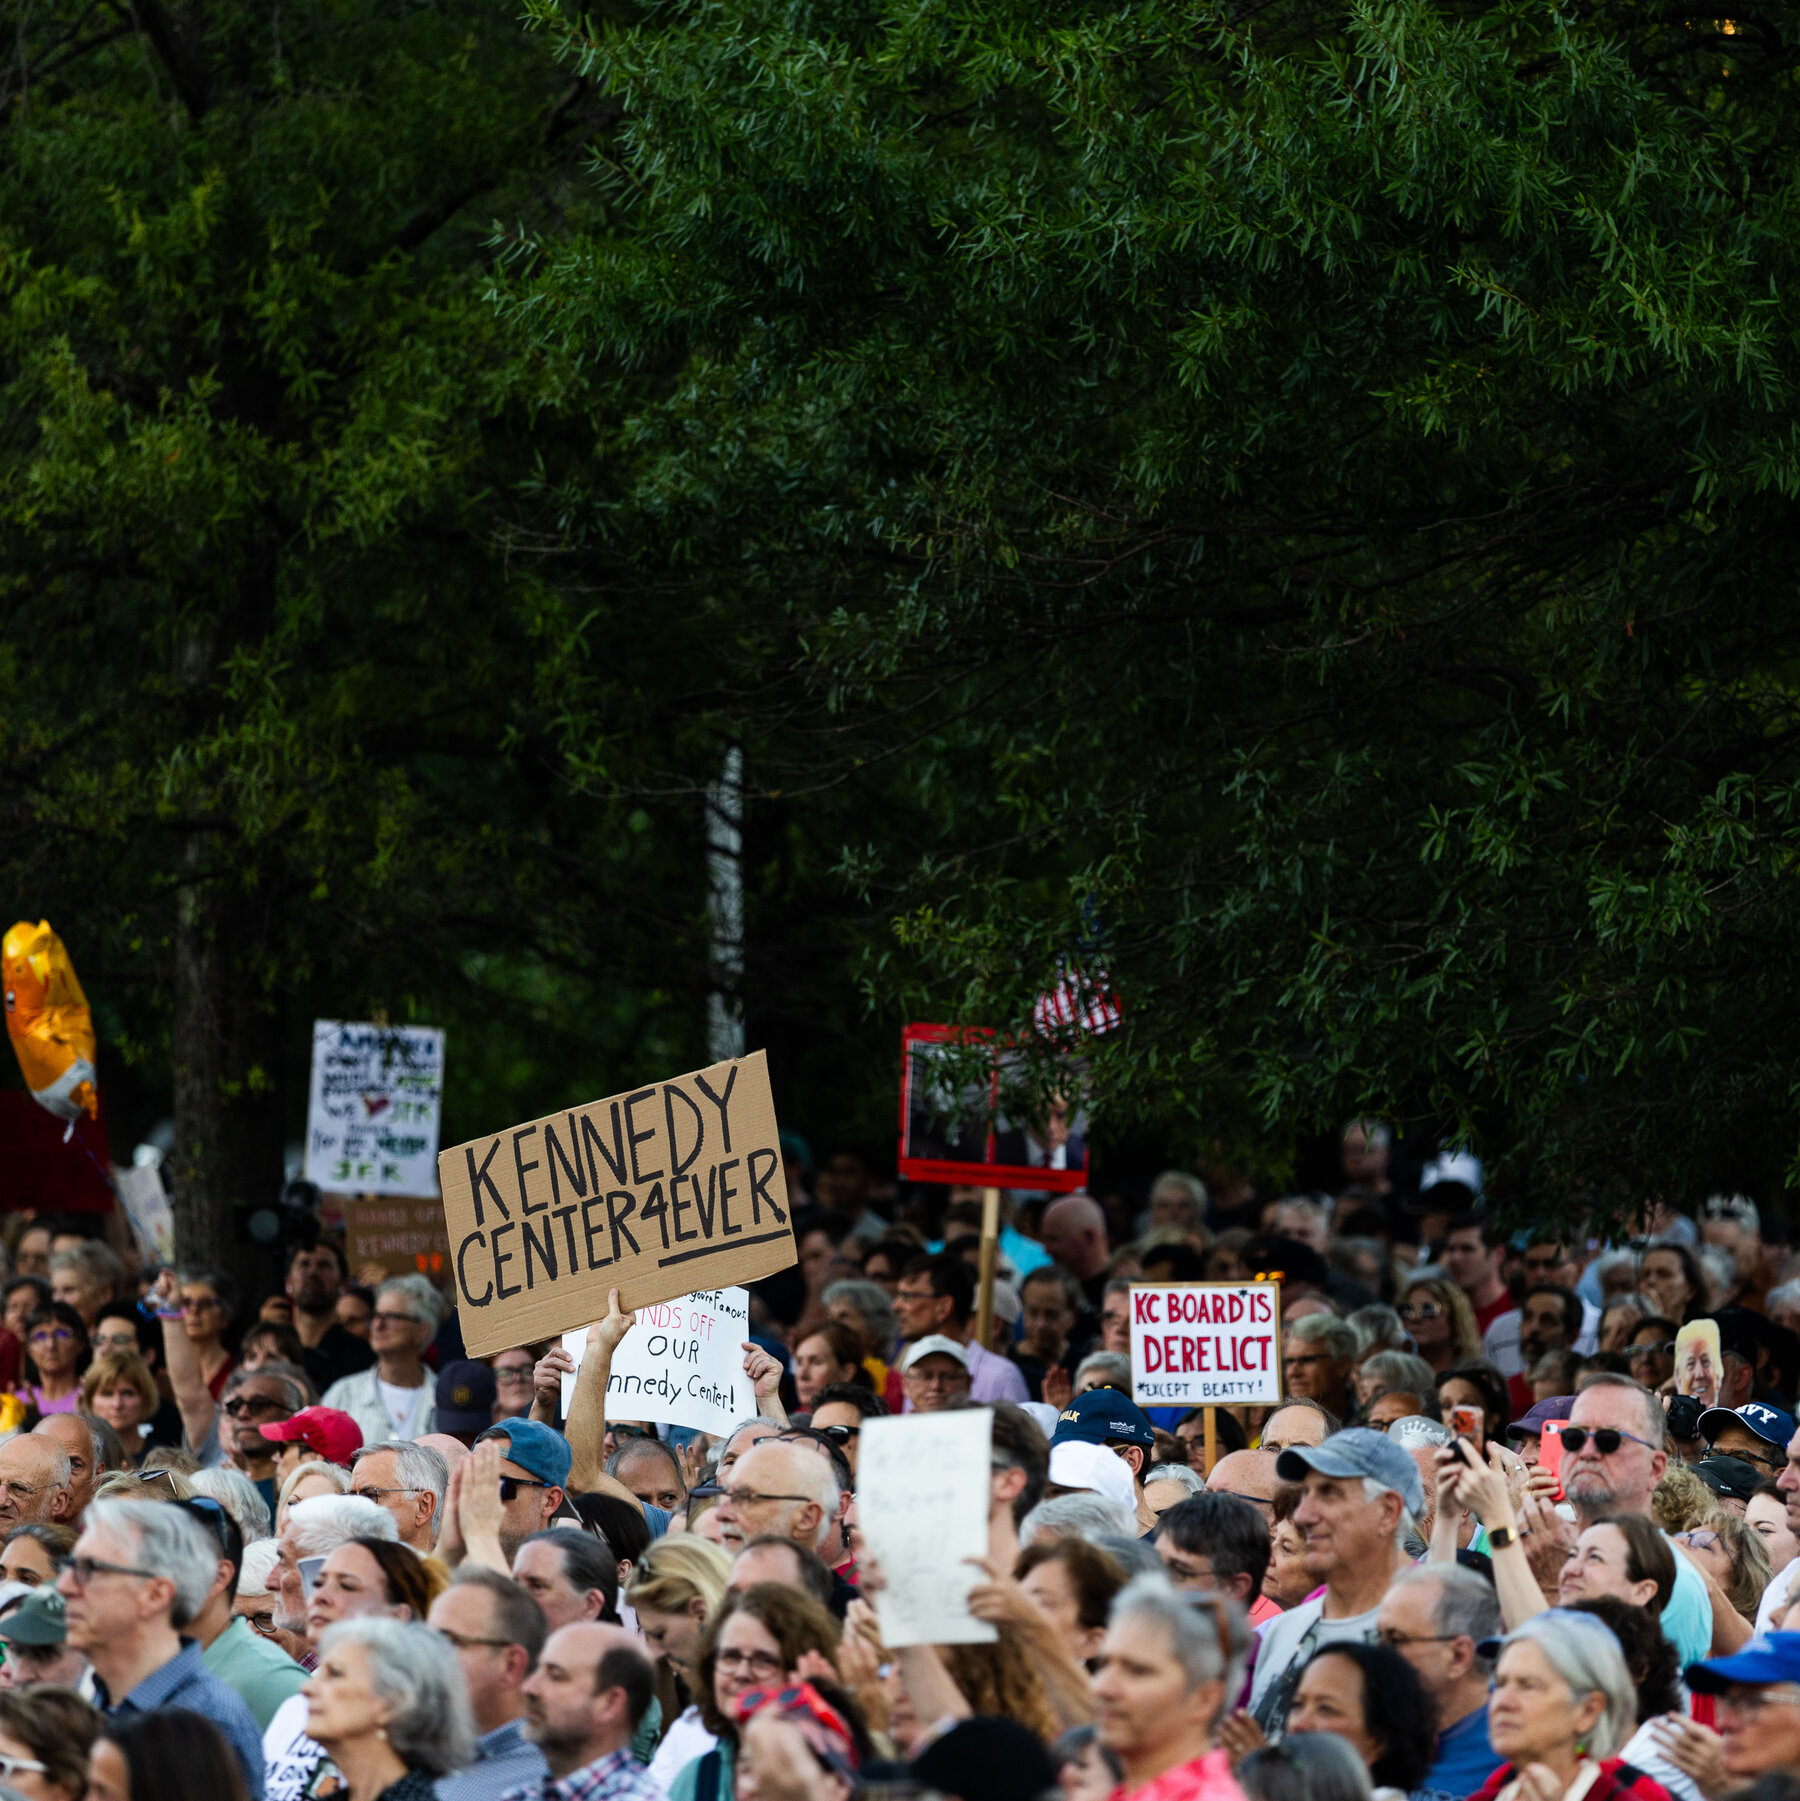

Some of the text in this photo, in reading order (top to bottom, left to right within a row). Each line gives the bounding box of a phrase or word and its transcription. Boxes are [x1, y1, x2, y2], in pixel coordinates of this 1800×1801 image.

[465, 1066, 738, 1227] KENNEDY
[634, 1304, 717, 1341] NDS OFF
[1135, 1293, 1161, 1324] KC
[1250, 1293, 1271, 1323] IS
[648, 1335, 700, 1364] OUR
[1144, 1335, 1272, 1373] DERELICT
[607, 1369, 736, 1414] nnedy Center!
[1202, 1379, 1263, 1397] BEATTY!
